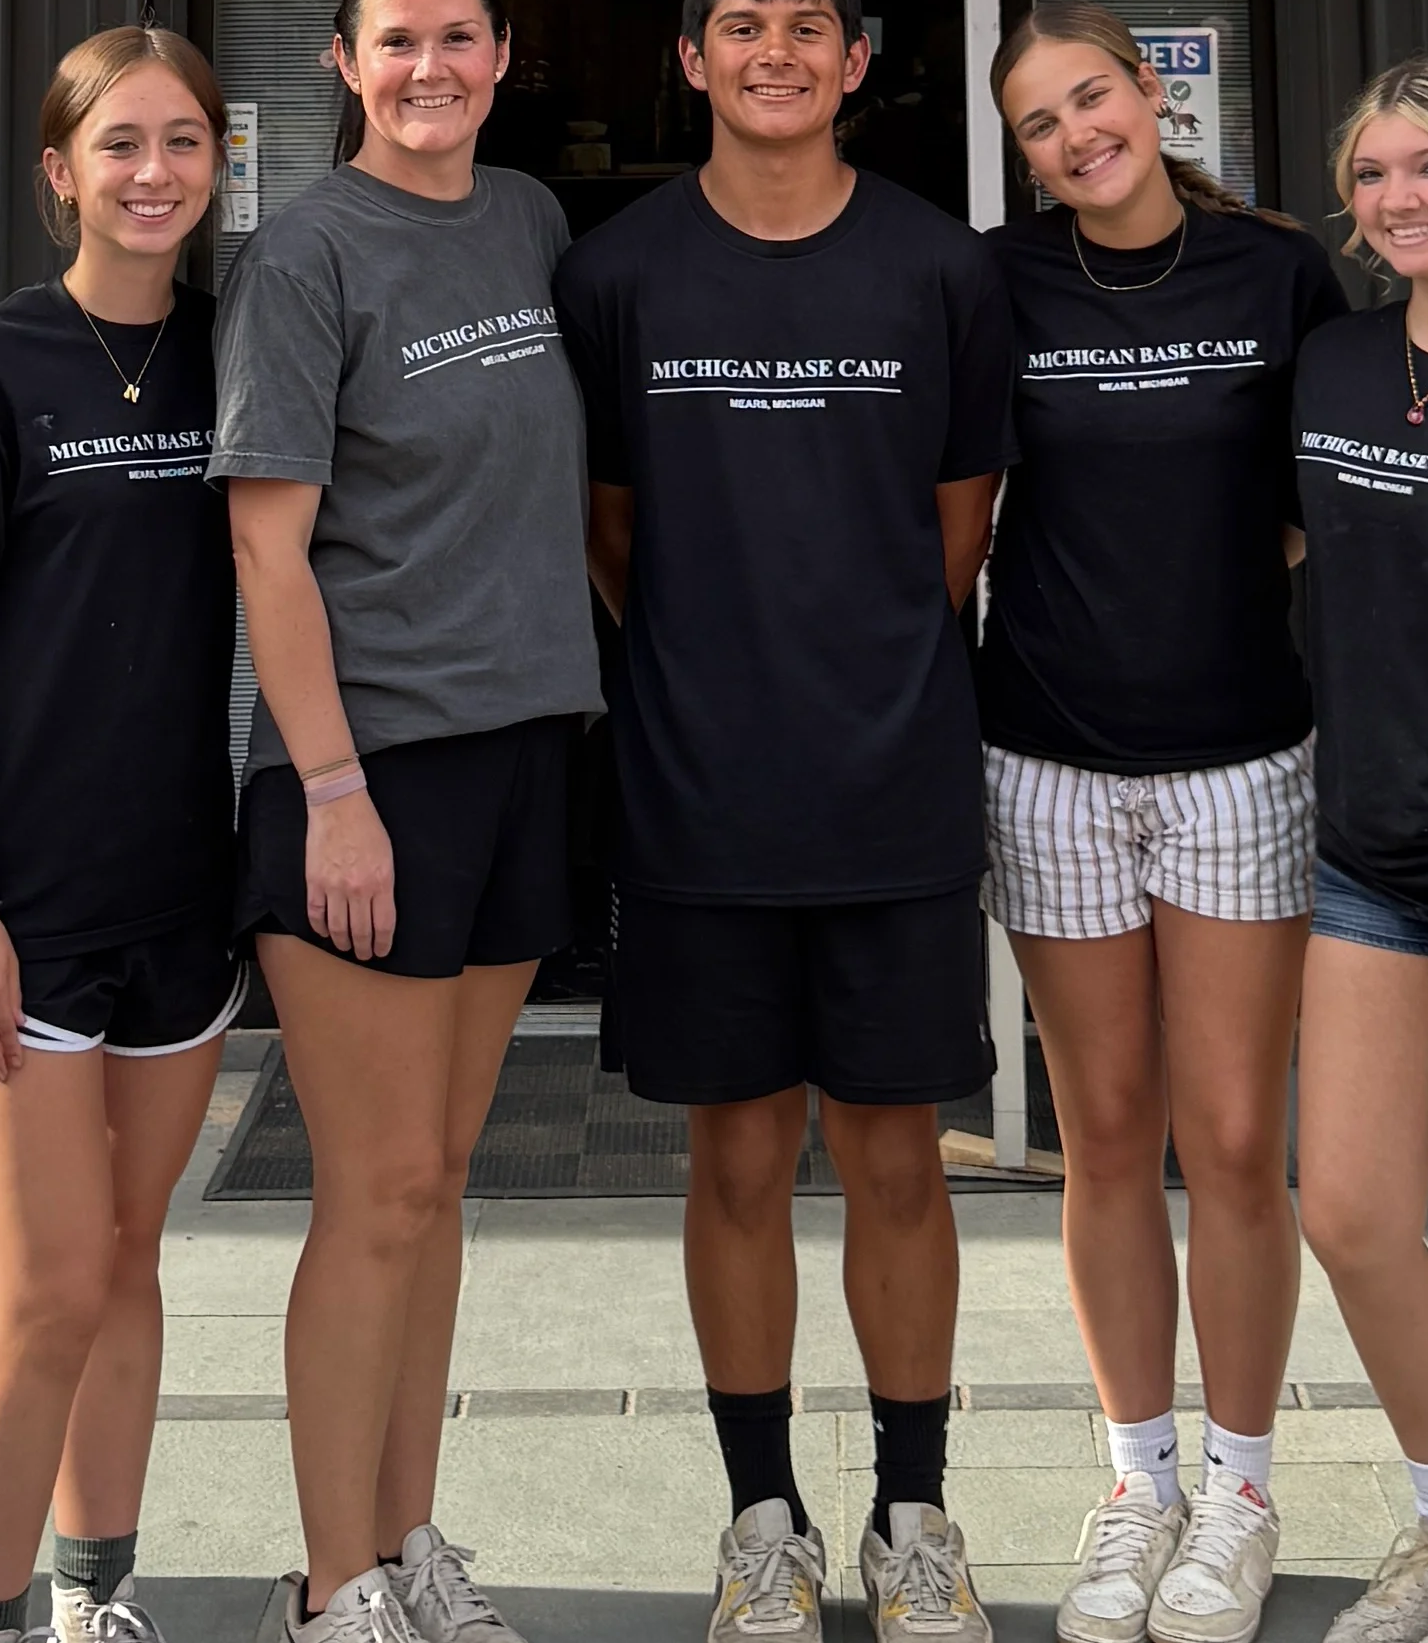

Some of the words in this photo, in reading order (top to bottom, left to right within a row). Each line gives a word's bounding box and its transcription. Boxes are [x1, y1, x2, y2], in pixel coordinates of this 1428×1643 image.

[400, 318, 498, 365] MICHIGAN
[1027, 347, 1136, 369] MICHIGAN
[1138, 342, 1194, 364] BASE
[1196, 339, 1258, 358] CAMP
[651, 360, 771, 380] MICHIGAN
[775, 359, 833, 379] BASE
[837, 358, 902, 379] CAMP
[1138, 375, 1190, 390] MICHIGAN
[729, 397, 771, 410] MEARS,
[772, 397, 826, 409] MICHIGAN
[48, 434, 155, 462] MICHIGAN
[156, 430, 204, 451] BASE
[1300, 431, 1386, 462] MICHIGAN
